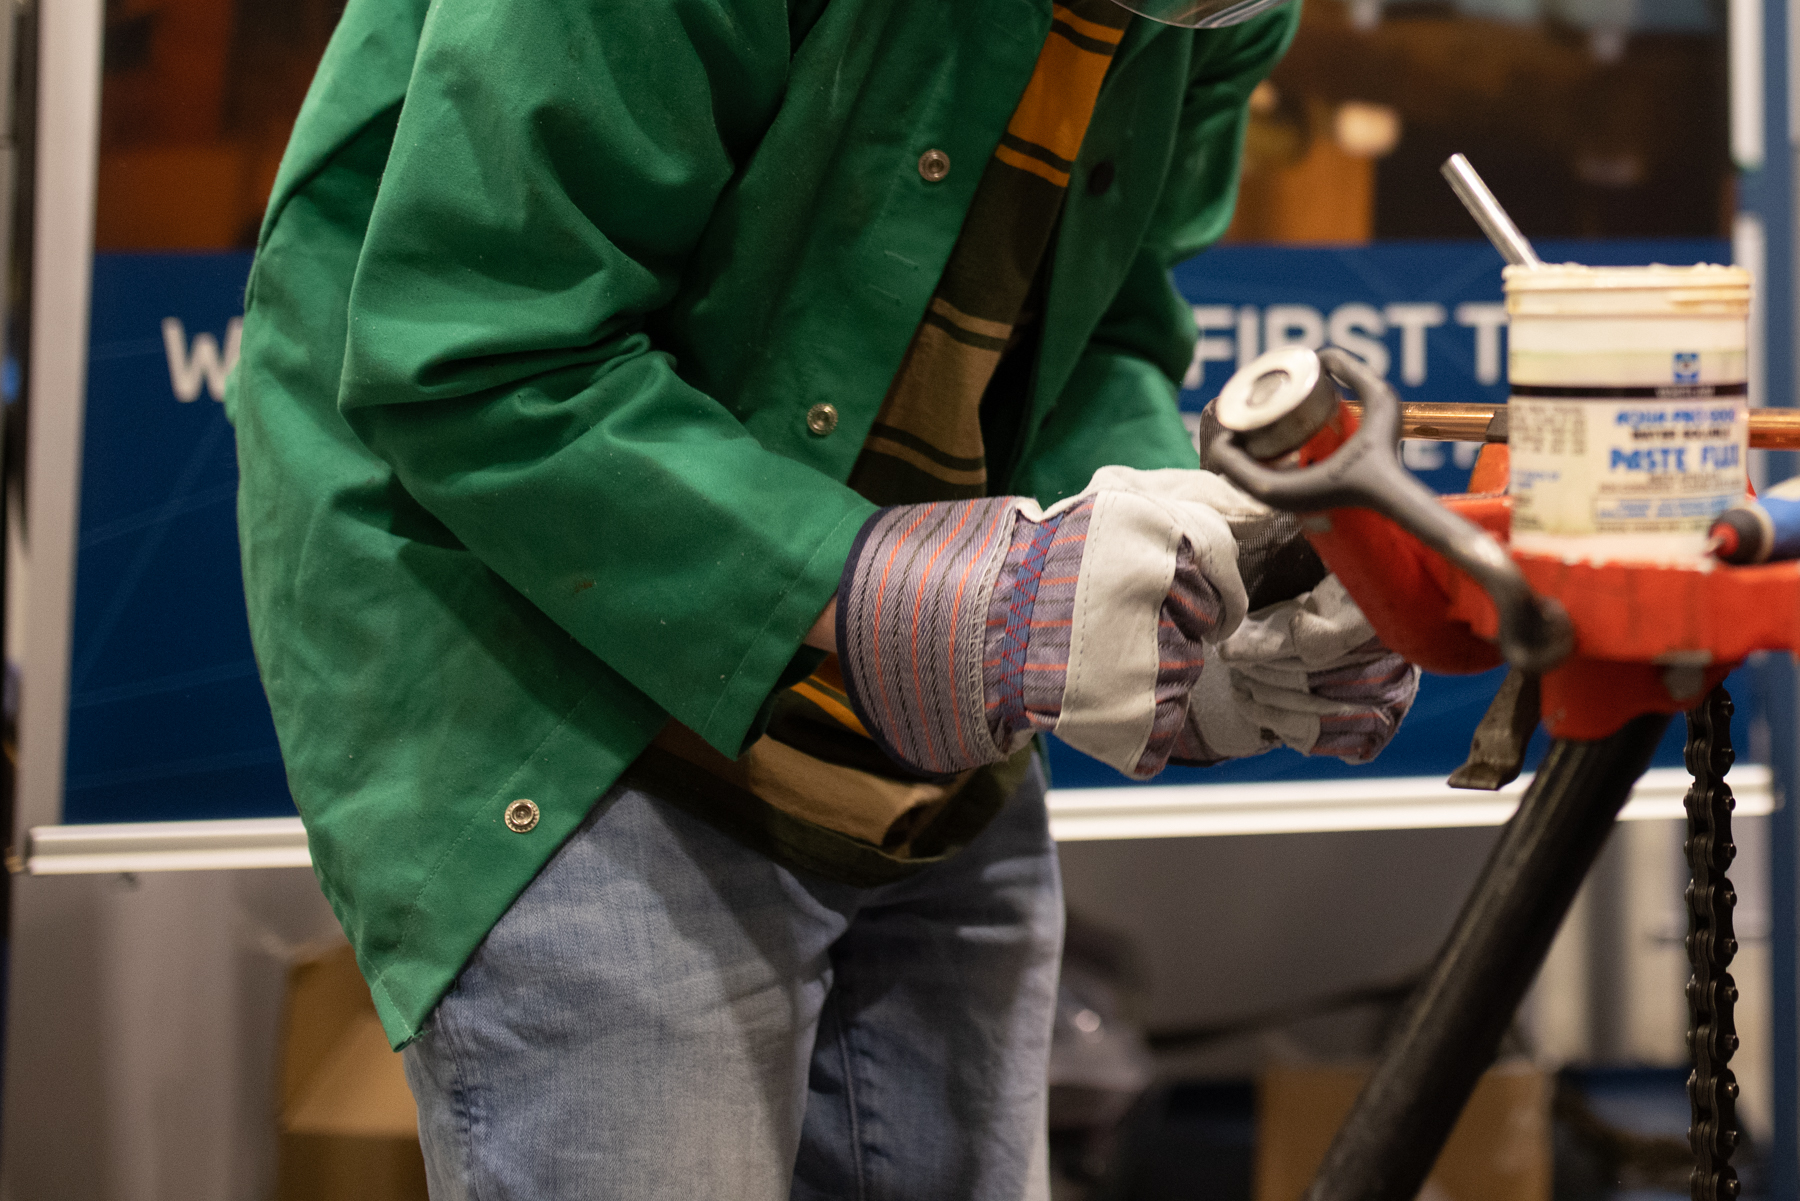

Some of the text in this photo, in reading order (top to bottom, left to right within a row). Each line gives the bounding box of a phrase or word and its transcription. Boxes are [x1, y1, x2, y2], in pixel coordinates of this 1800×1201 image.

[161, 303, 1510, 402] W FIRST T
